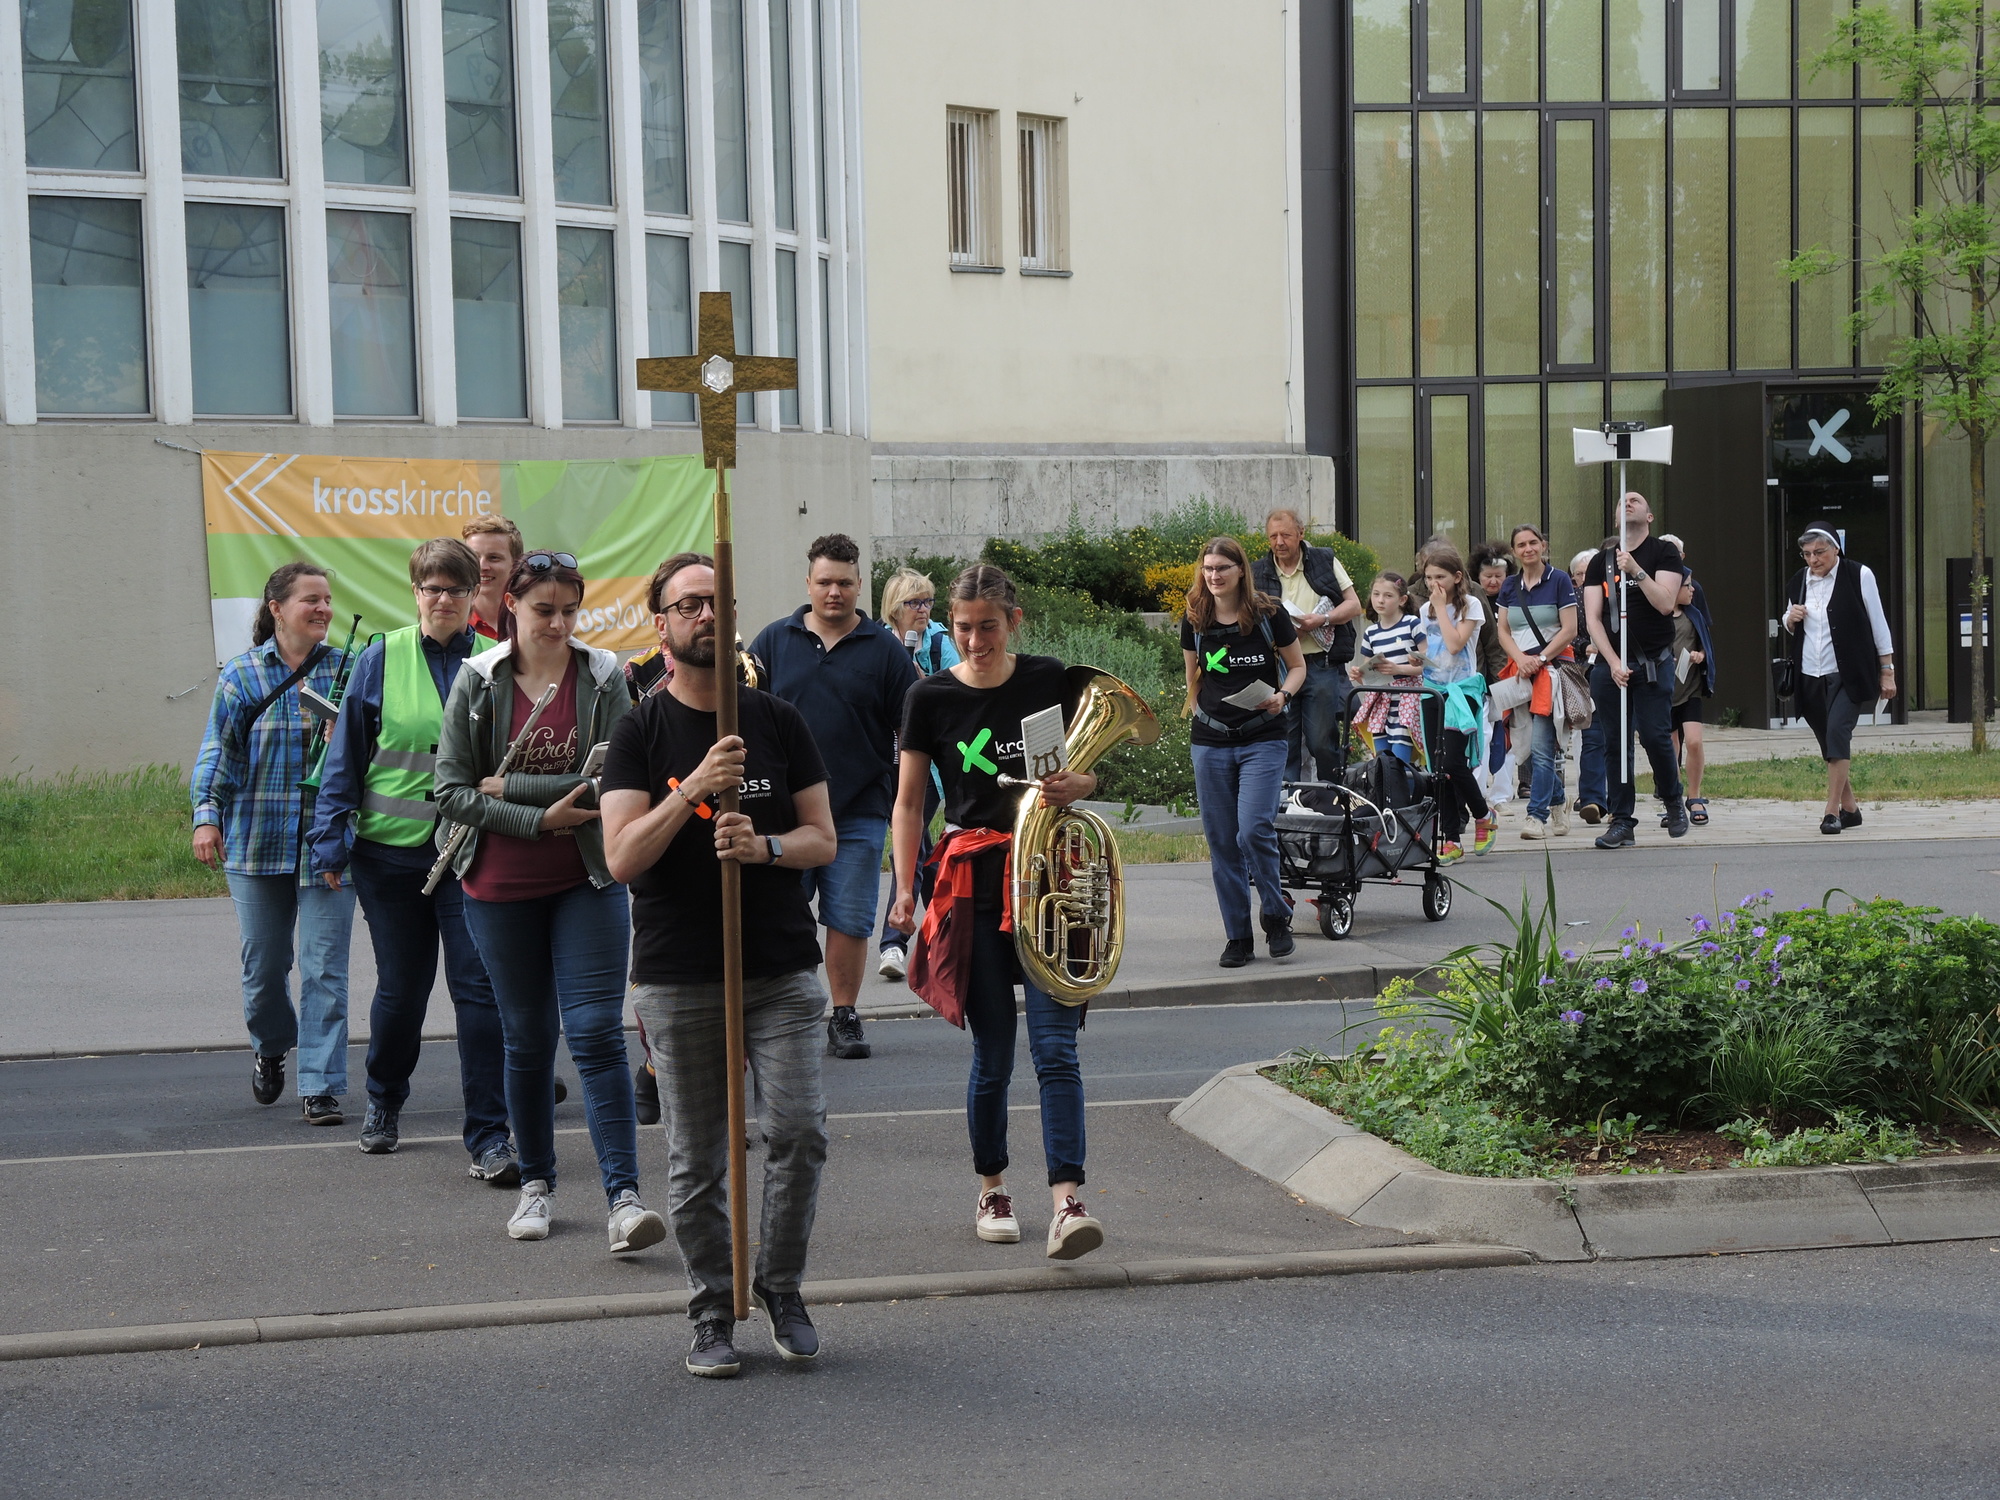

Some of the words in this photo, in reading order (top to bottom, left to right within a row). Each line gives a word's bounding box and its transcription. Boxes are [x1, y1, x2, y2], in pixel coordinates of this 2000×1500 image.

[313, 476, 491, 517] krosskirche
[577, 597, 655, 632] osslou
[1229, 654, 1265, 664] kross
[508, 725, 577, 773] Hard
[995, 740, 1025, 755] kro
